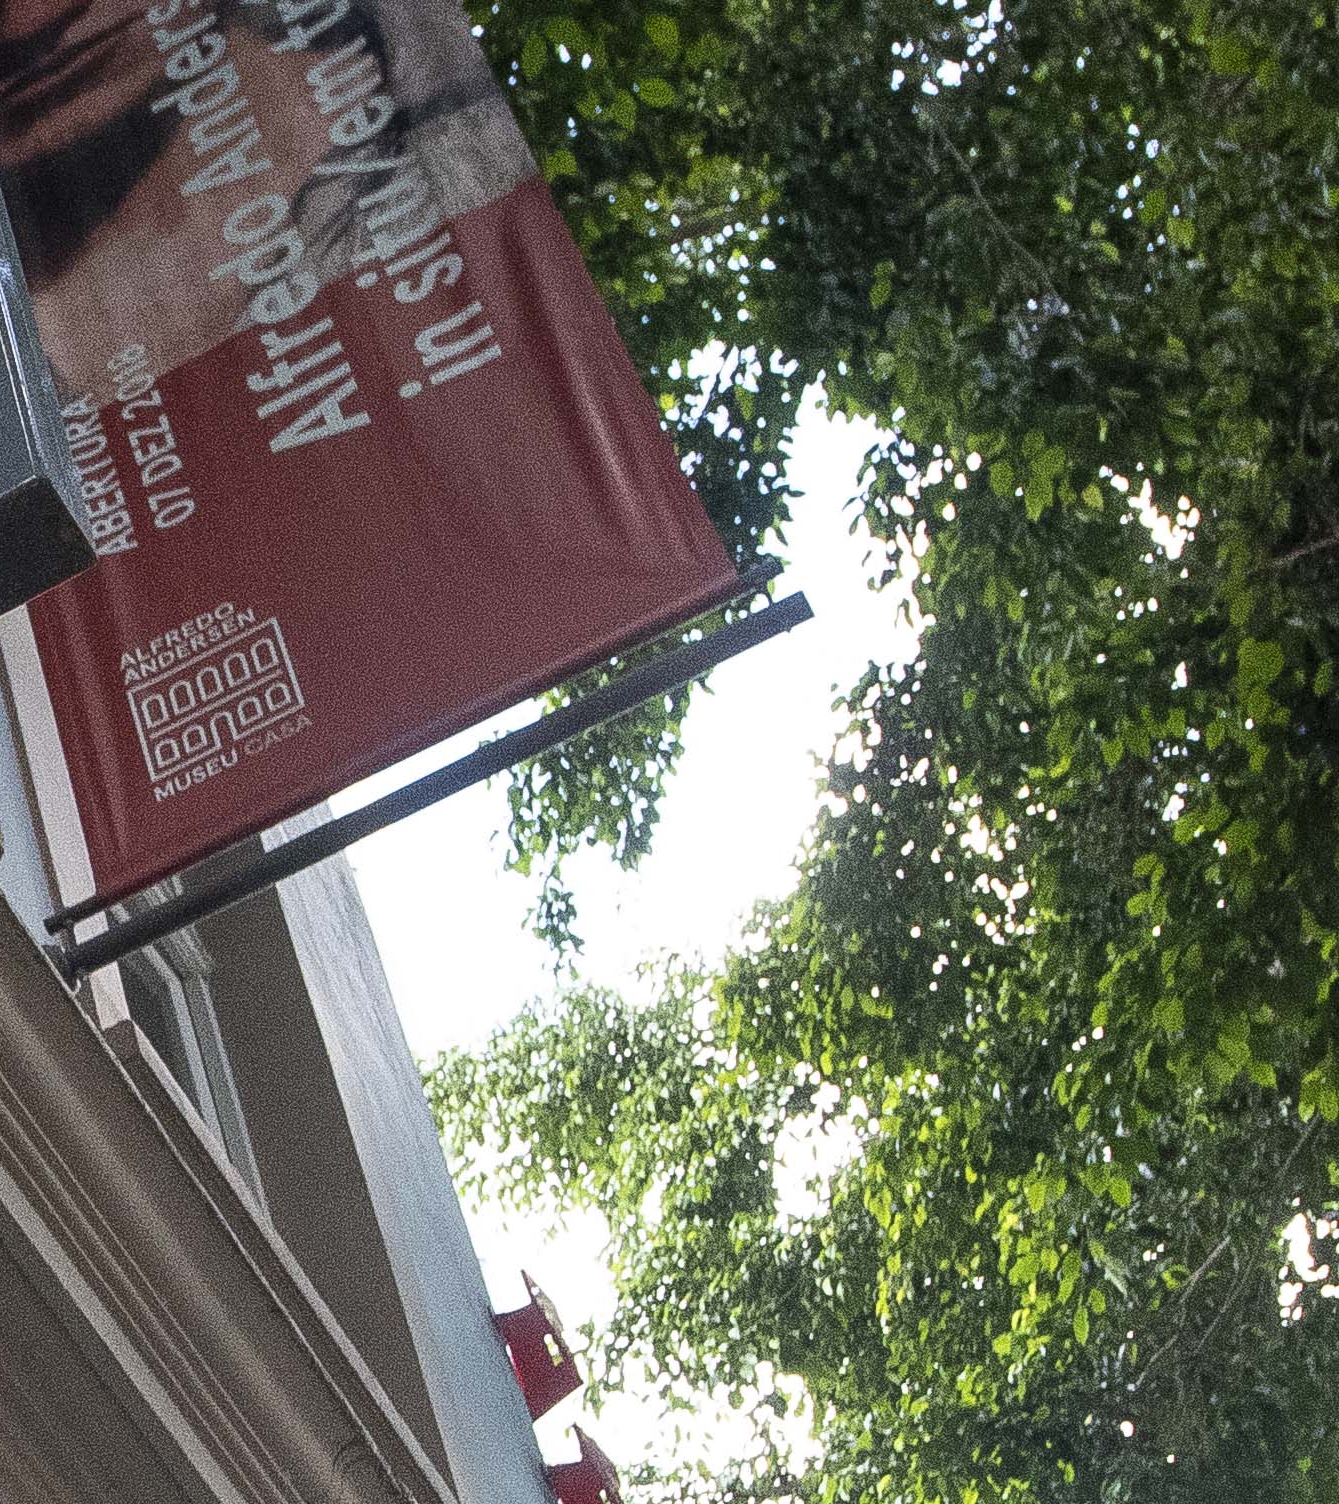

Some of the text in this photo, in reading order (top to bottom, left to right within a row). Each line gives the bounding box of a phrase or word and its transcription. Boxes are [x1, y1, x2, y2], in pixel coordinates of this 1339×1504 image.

[208, 192, 373, 453] Alfredo
[398, 301, 501, 401] in
[60, 391, 140, 555] ABERTURA
[106, 342, 197, 530] 07 DEZ 2018
[120, 603, 234, 671] ALFREDO
[122, 607, 256, 682] ANDERSEN
[154, 712, 312, 803] MUSEU CASA
